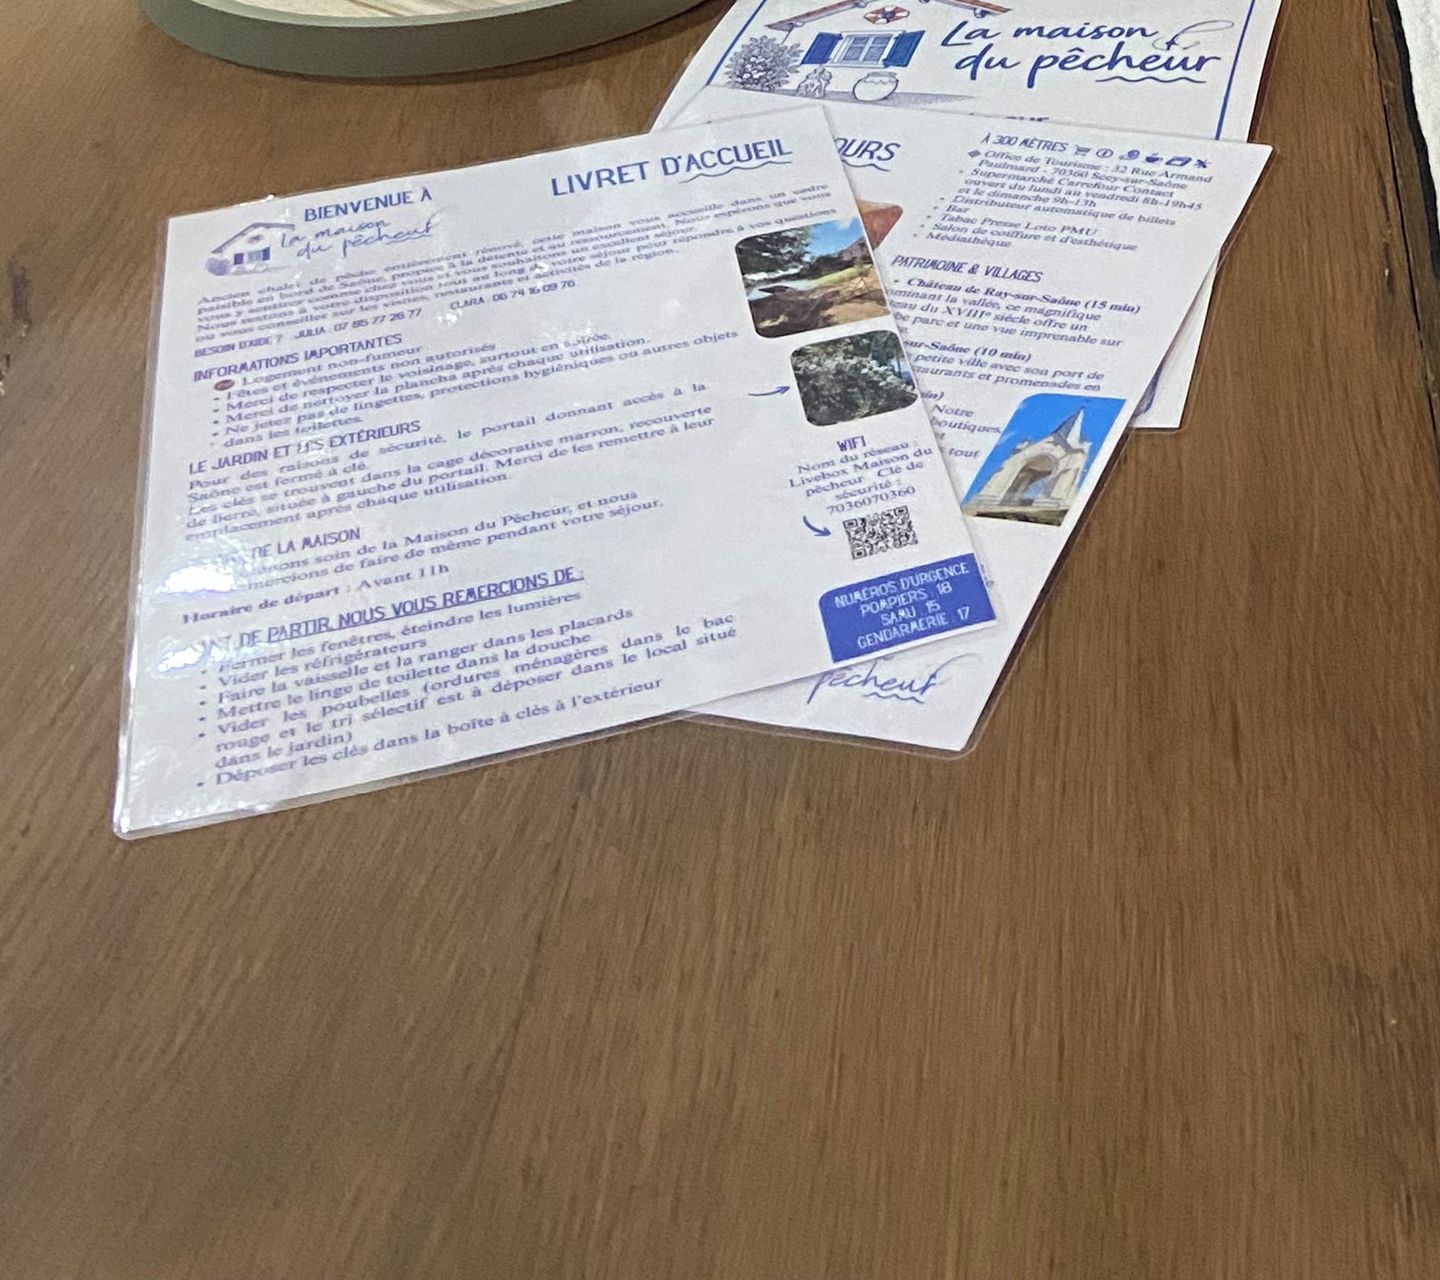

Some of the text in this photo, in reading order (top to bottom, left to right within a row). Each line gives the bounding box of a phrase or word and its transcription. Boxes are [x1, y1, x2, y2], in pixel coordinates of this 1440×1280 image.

[941, 20, 1159, 46] La maison
[954, 41, 1221, 88] du pêcheur
[994, 135, 1017, 146] 300
[551, 139, 793, 197] LIVRET D'ACCUEIL
[304, 186, 432, 222] BIENVENUE À
[297, 221, 436, 259] du pêcheur
[891, 255, 968, 273] PATRIMOINE
[984, 265, 1043, 282] VILLAGES
[194, 333, 402, 381] INFORMATIONS IMPORTANTES
[328, 345, 423, 370] non-fumeur
[190, 420, 421, 474] LE JARDIN ET EXTÉRIEURS
[837, 435, 867, 452] WIFI
[789, 446, 933, 488] Livebox Maison du
[798, 459, 835, 474] Nom
[840, 452, 859, 464] du
[805, 460, 924, 498] pêcheur Clé de
[834, 480, 893, 501] sécurité
[277, 527, 361, 555] LA MAISON
[357, 544, 376, 555] de
[383, 540, 398, 550] la
[404, 526, 469, 547] Maison
[474, 519, 496, 533] du
[578, 500, 594, 510] et
[598, 491, 638, 505] nous
[259, 599, 279, 610] de
[284, 587, 339, 605] départ
[358, 572, 412, 591] Avant
[339, 606, 385, 630] NOUS
[392, 595, 437, 618] VOUS
[443, 572, 549, 608] REMERCIONS
[554, 566, 576, 583] DE
[860, 582, 953, 617] POMPIERS 18
[292, 645, 315, 658] les
[401, 615, 474, 637] éteindre
[480, 608, 501, 620] les
[508, 592, 581, 614] lumières
[857, 606, 970, 650] GENDARMERIE 17
[881, 601, 940, 627] SAMU 15
[218, 608, 634, 704] Faire la vaisselle et la ranger dans les placards
[218, 670, 269, 687] Vider
[275, 664, 298, 677] les
[303, 754, 328, 766] les
[333, 744, 368, 762] clés
[374, 734, 419, 752] dans
[424, 728, 441, 740] la
[448, 715, 494, 734] boîte
[500, 712, 510, 724] à
[516, 703, 550, 720] clés
[556, 700, 566, 711] à
[215, 752, 261, 769] dans
[267, 747, 283, 758] le
